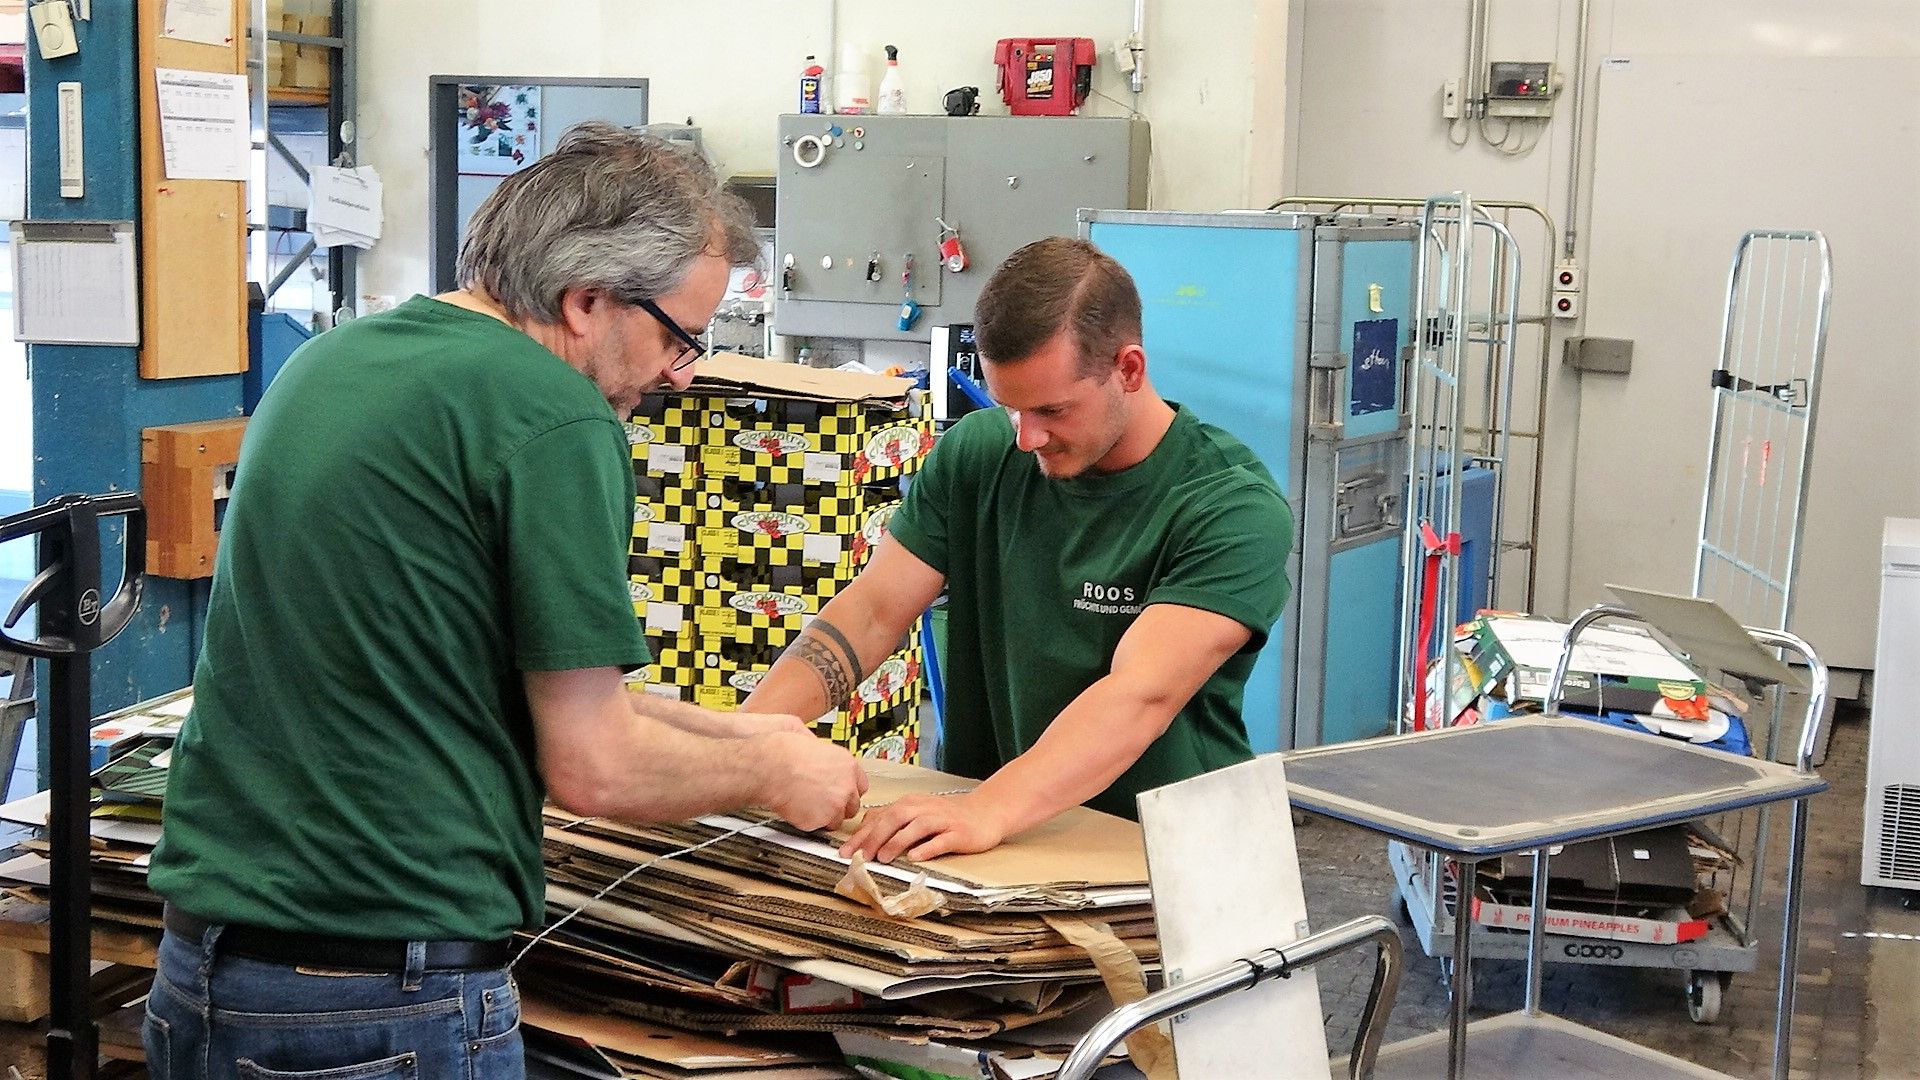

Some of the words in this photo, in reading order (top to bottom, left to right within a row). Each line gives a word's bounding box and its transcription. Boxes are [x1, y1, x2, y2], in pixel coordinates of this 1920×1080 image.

[1083, 581, 1135, 602] ROOS
[1100, 604, 1119, 615] UND
[1516, 912, 1570, 927] PRIUM
[1572, 918, 1640, 934] PINEAPPLES
